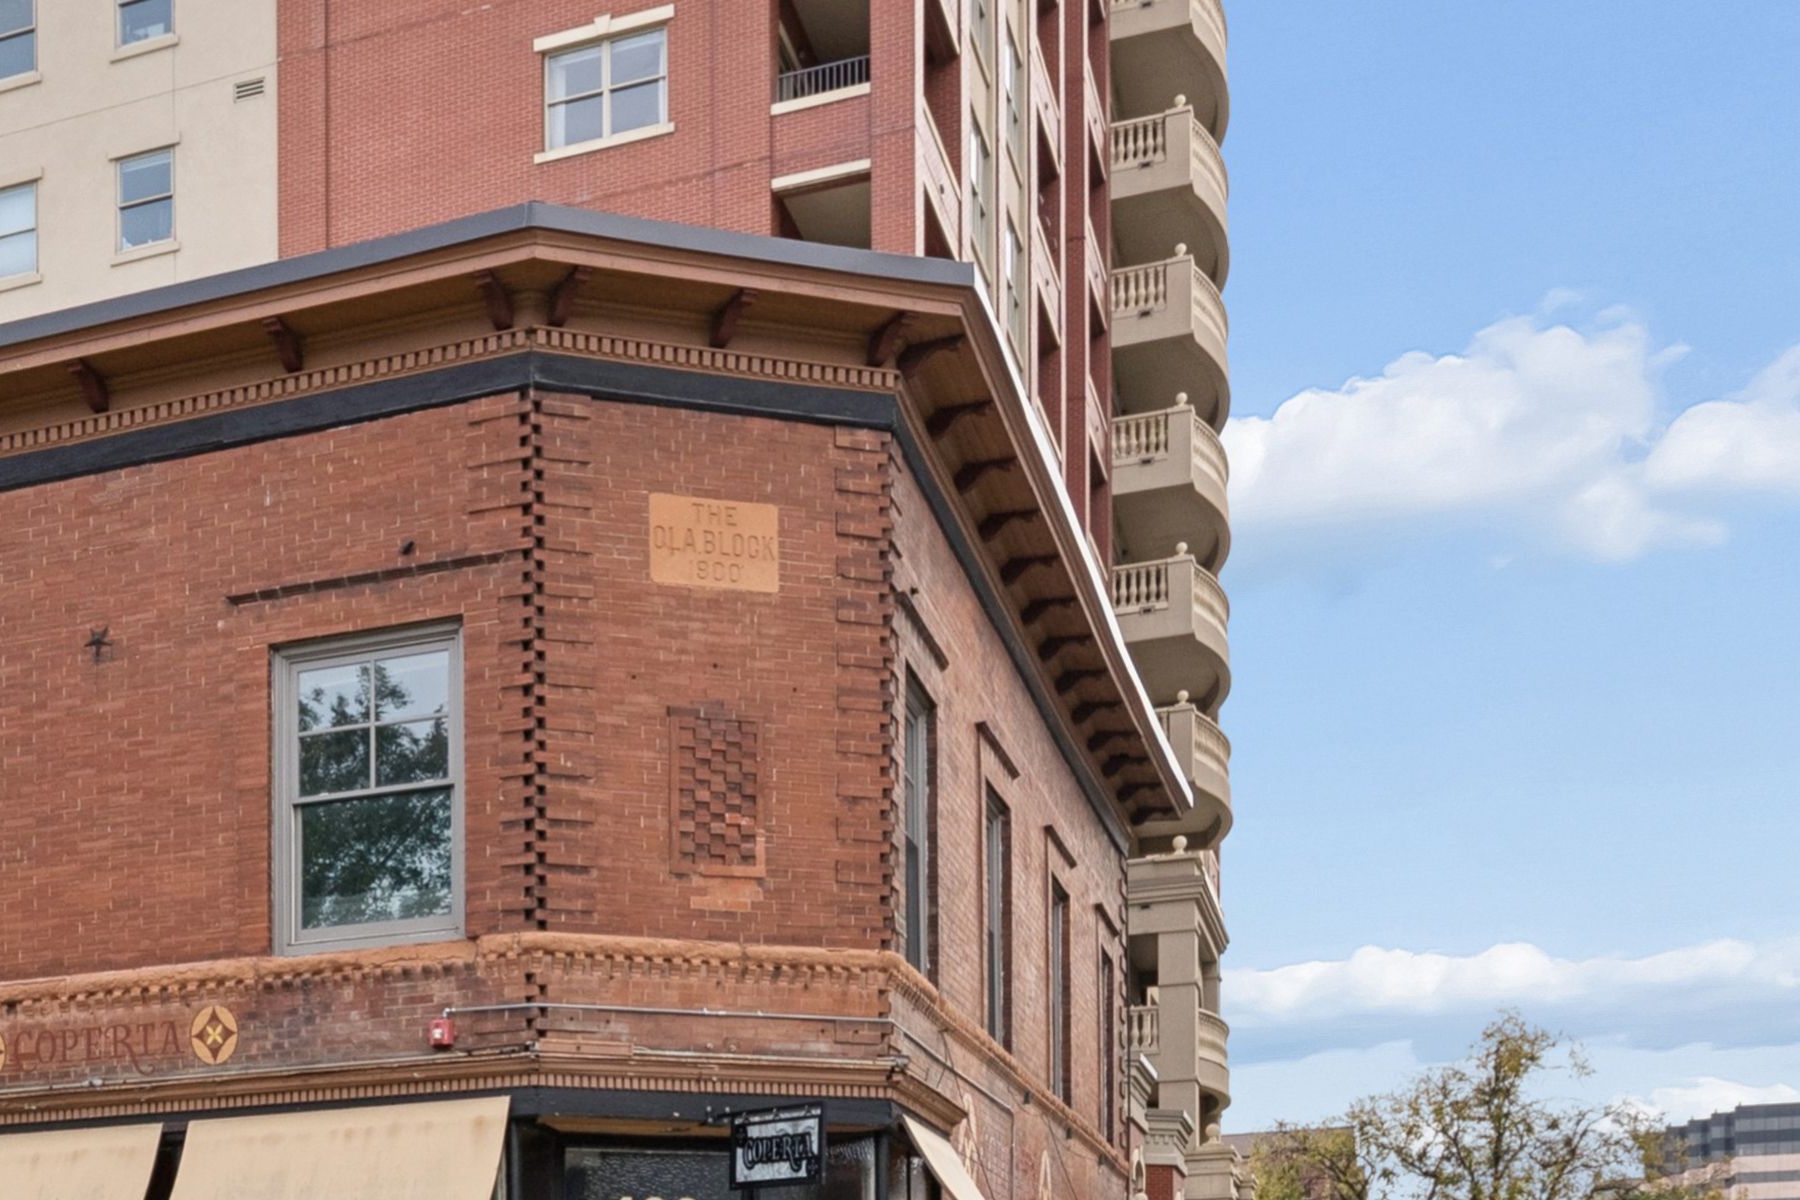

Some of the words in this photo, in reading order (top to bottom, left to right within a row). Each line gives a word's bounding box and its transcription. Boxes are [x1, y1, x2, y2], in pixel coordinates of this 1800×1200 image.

[691, 502, 738, 527] THE
[703, 529, 776, 561] BLOCK
[14, 1020, 185, 1076] COPERTA
[742, 1132, 815, 1173] COPERTA
